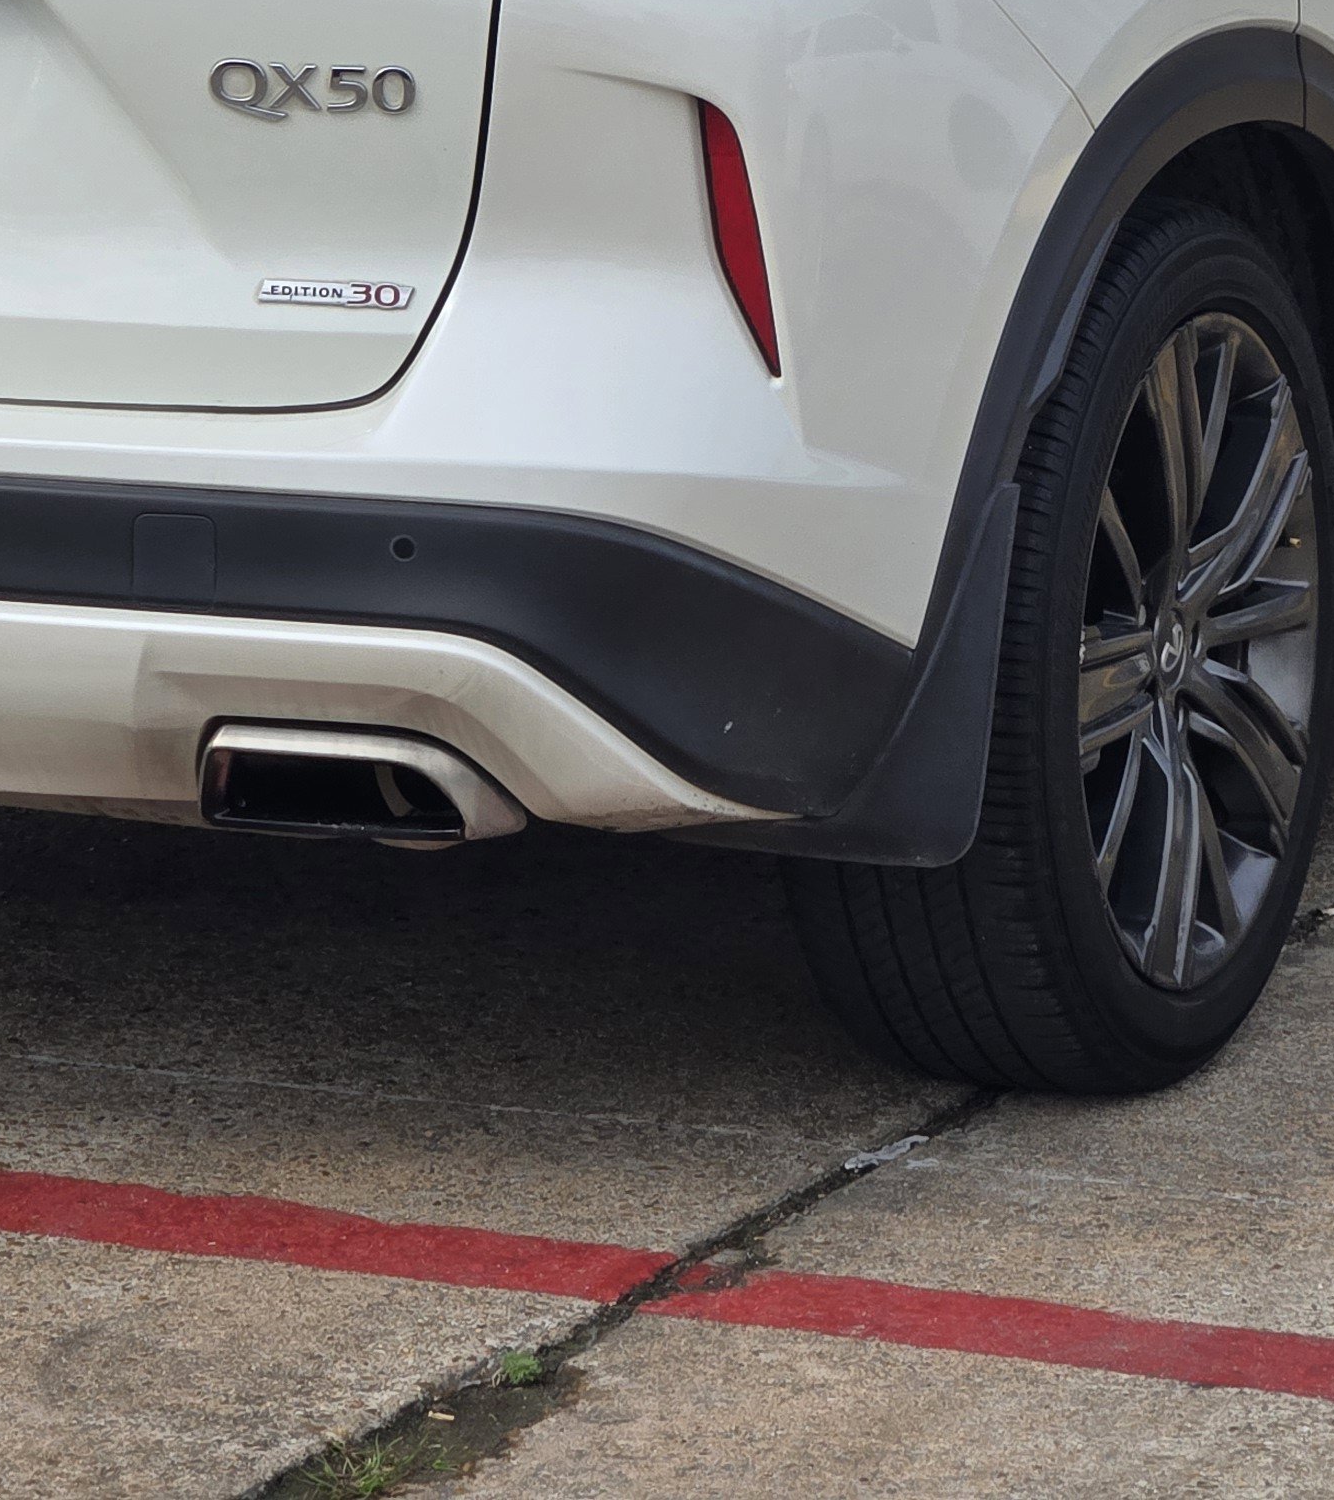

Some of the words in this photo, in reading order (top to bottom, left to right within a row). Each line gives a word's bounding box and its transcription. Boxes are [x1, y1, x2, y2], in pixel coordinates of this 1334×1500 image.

[209, 57, 416, 123] QX50
[270, 284, 343, 299] EDITION
[346, 282, 401, 307] 30
